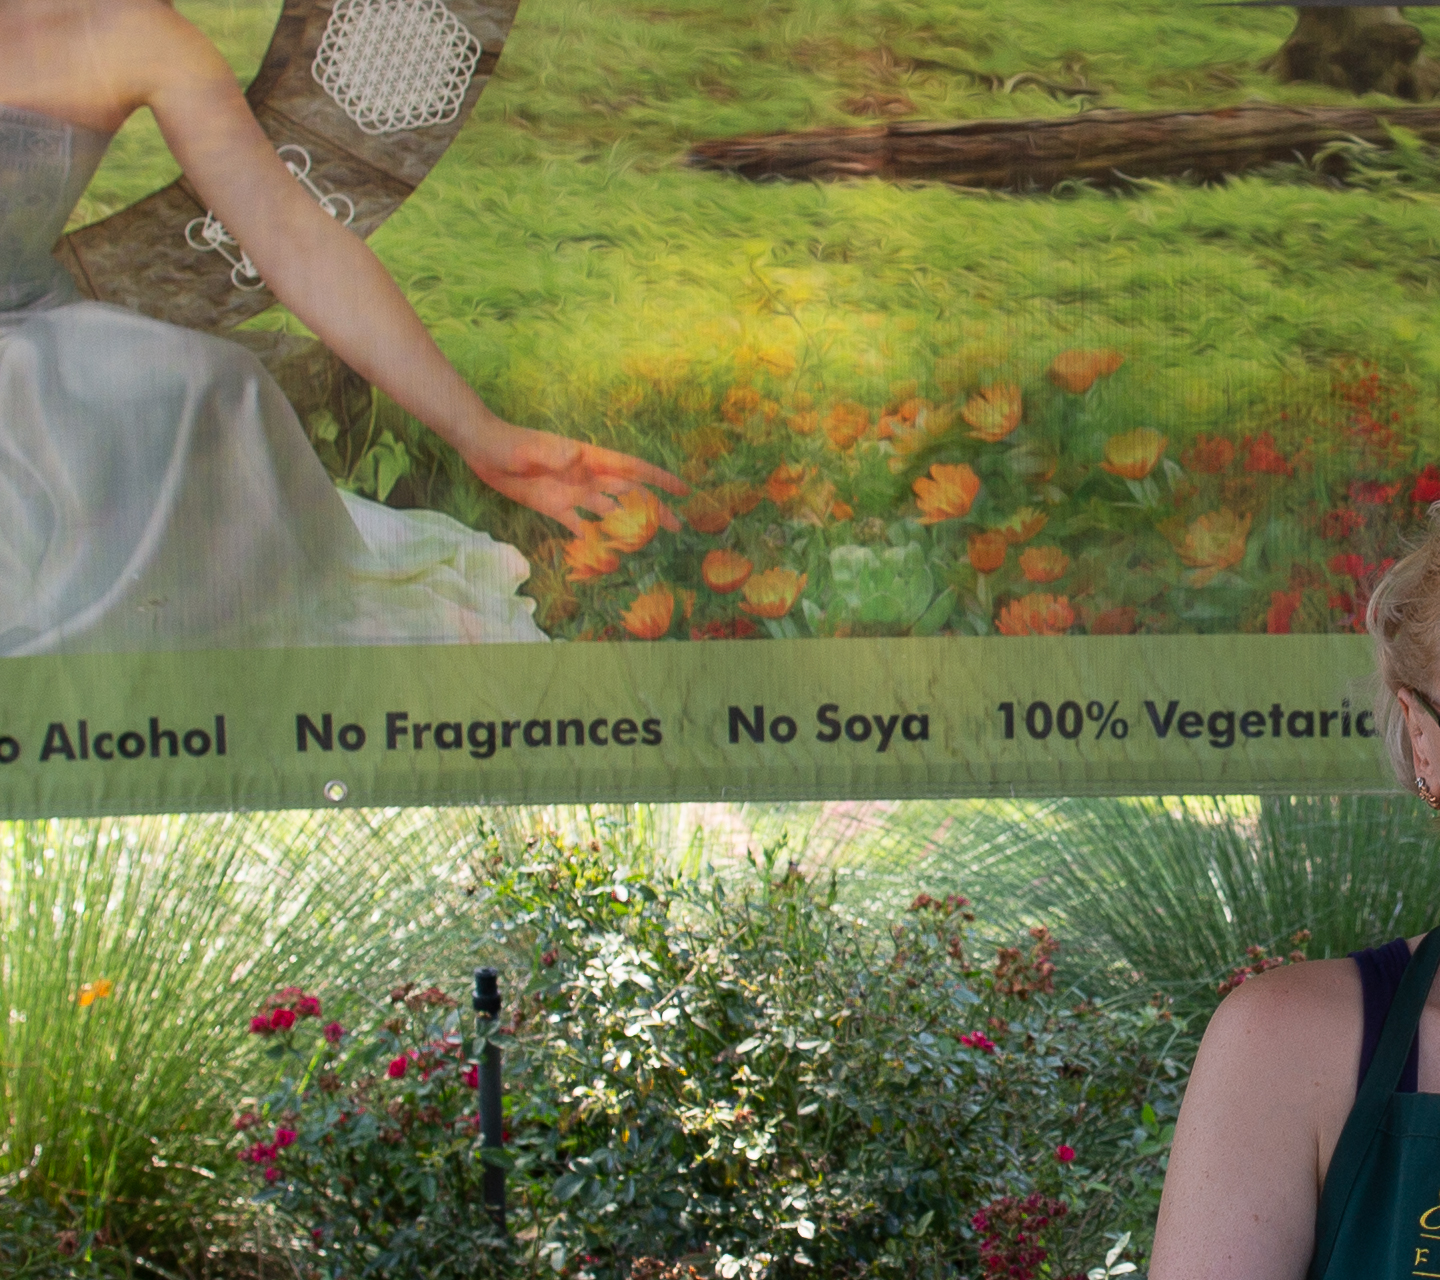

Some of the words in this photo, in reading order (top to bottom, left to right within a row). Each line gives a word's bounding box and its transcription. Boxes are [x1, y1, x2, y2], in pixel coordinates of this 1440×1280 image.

[40, 716, 227, 763] Alcohol
[295, 711, 366, 753] No
[386, 709, 663, 759] Fragrances
[727, 704, 797, 745] No
[816, 704, 931, 752] Soya
[996, 701, 1129, 742] 100%
[1145, 697, 1380, 745] Vegetaria
